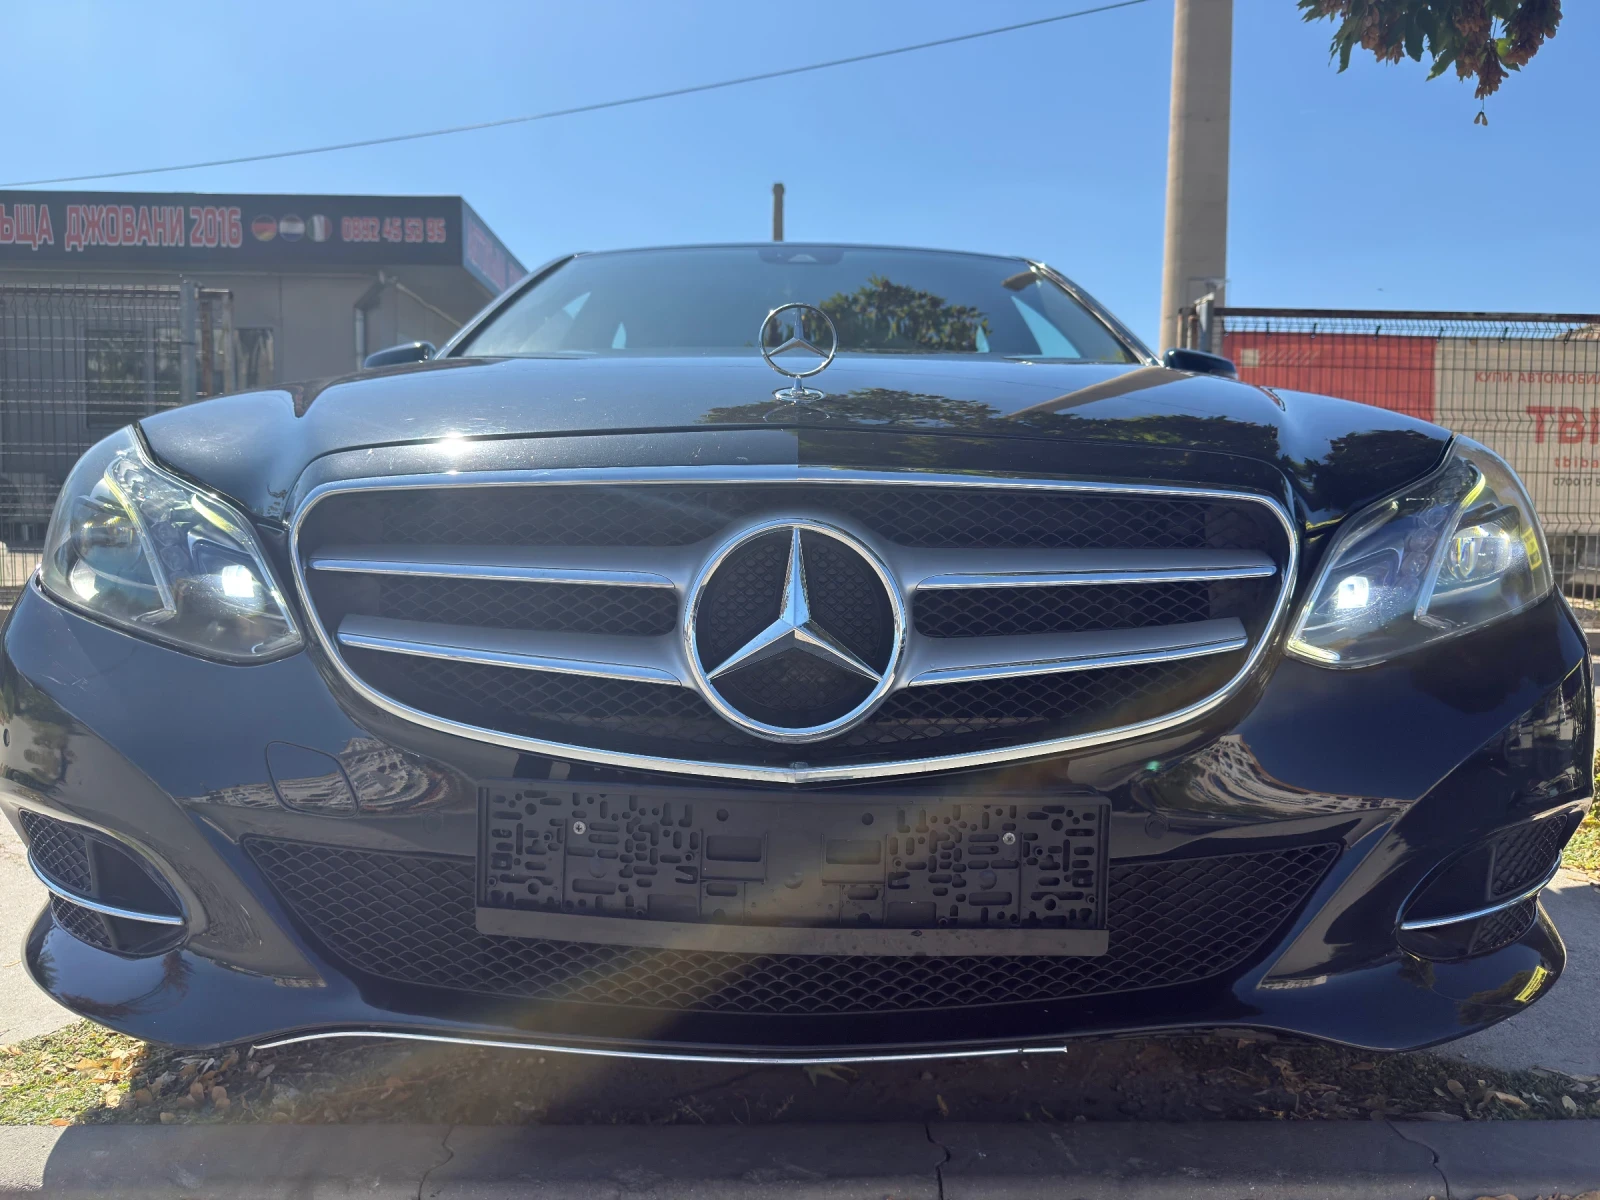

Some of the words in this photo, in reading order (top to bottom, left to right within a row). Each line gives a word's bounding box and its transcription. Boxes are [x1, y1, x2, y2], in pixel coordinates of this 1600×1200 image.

[65, 205, 184, 251] ДЖОВАНИ
[190, 206, 242, 247] 2016
[1475, 371, 1513, 383] КУПИ
[1553, 477, 1581, 487] 0700
